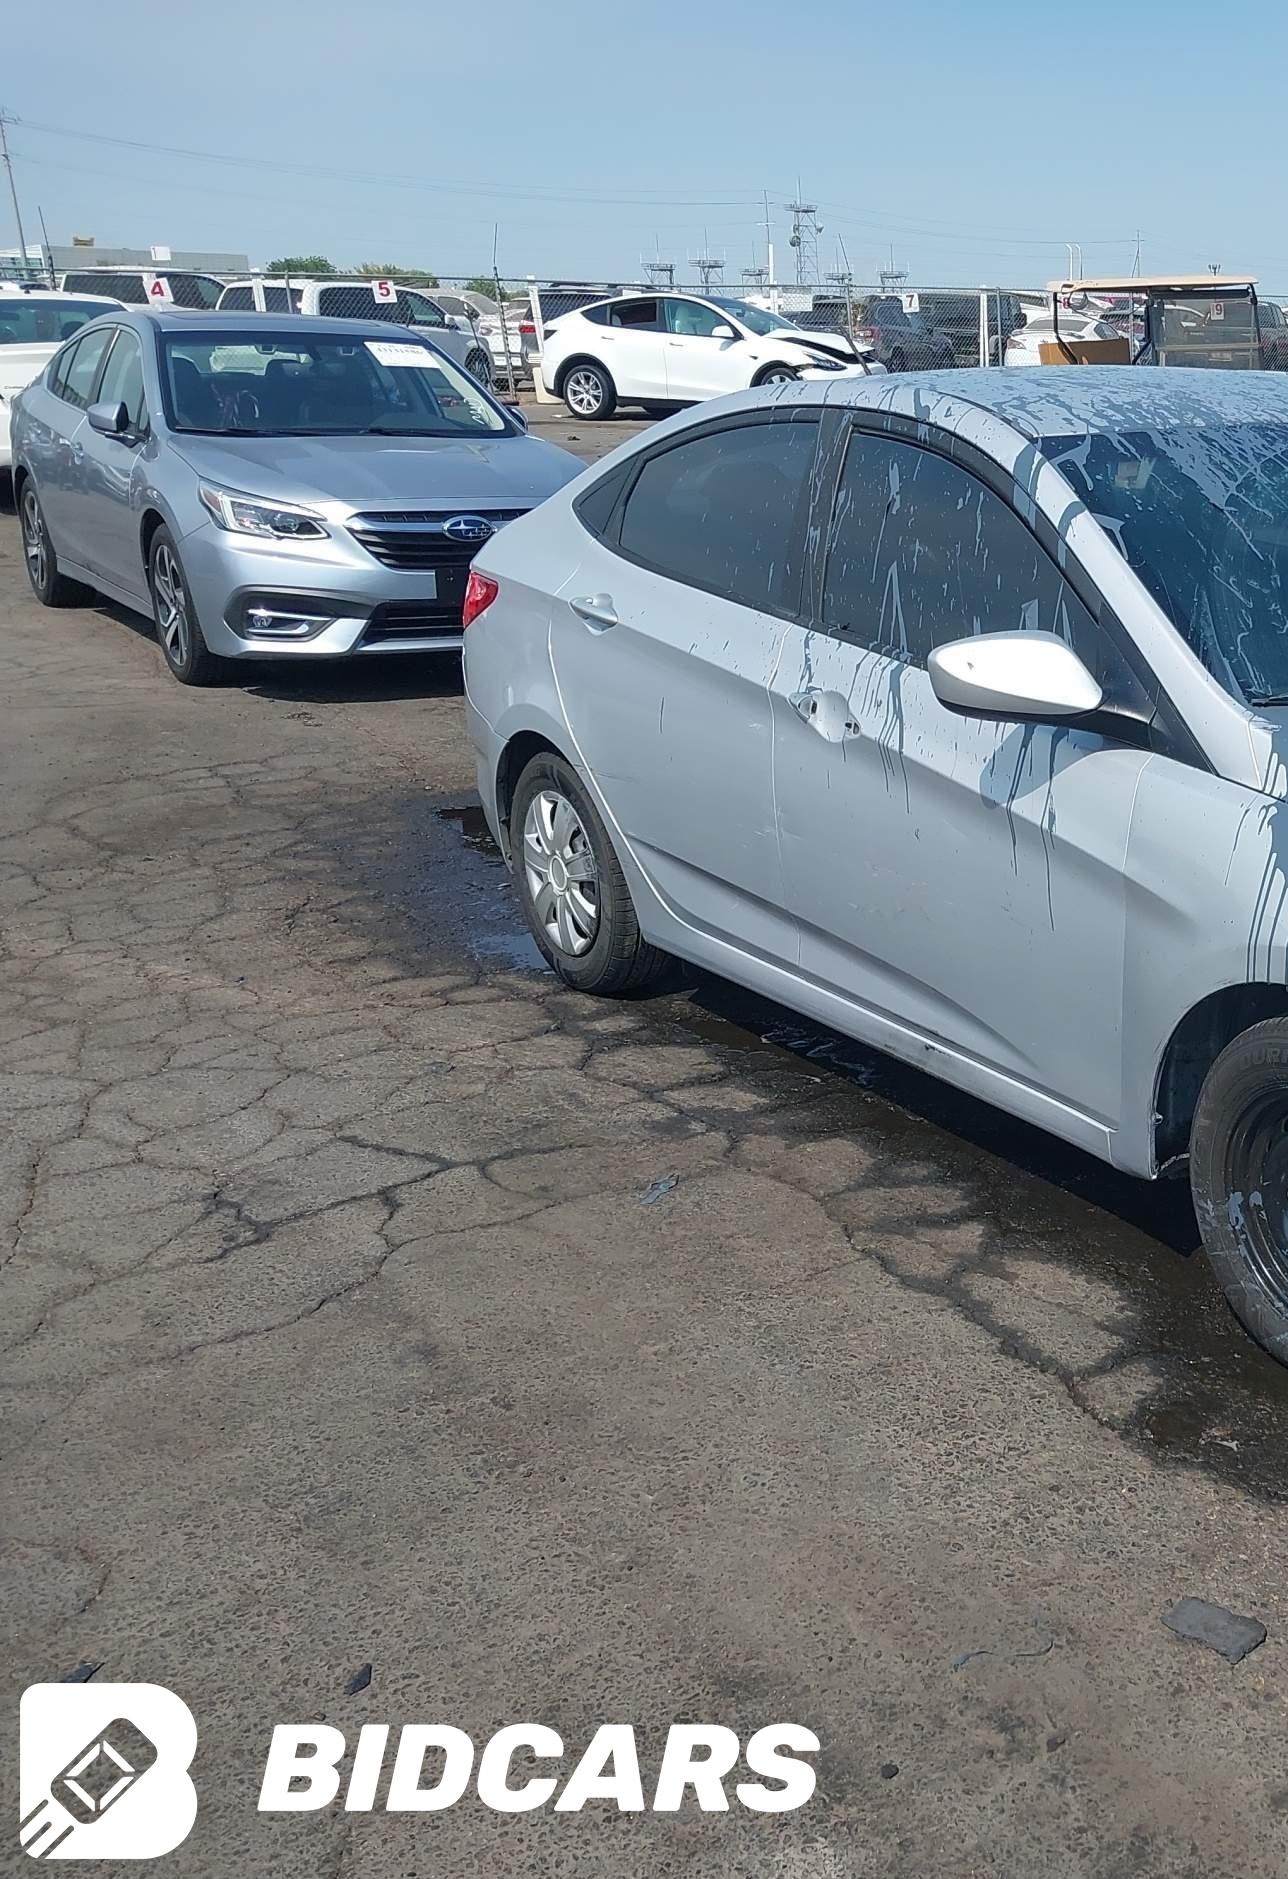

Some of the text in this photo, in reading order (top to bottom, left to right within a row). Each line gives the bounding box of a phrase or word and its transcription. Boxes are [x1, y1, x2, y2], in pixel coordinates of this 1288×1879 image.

[151, 281, 164, 296] 4
[378, 281, 390, 297] 5
[906, 294, 915, 308] 7
